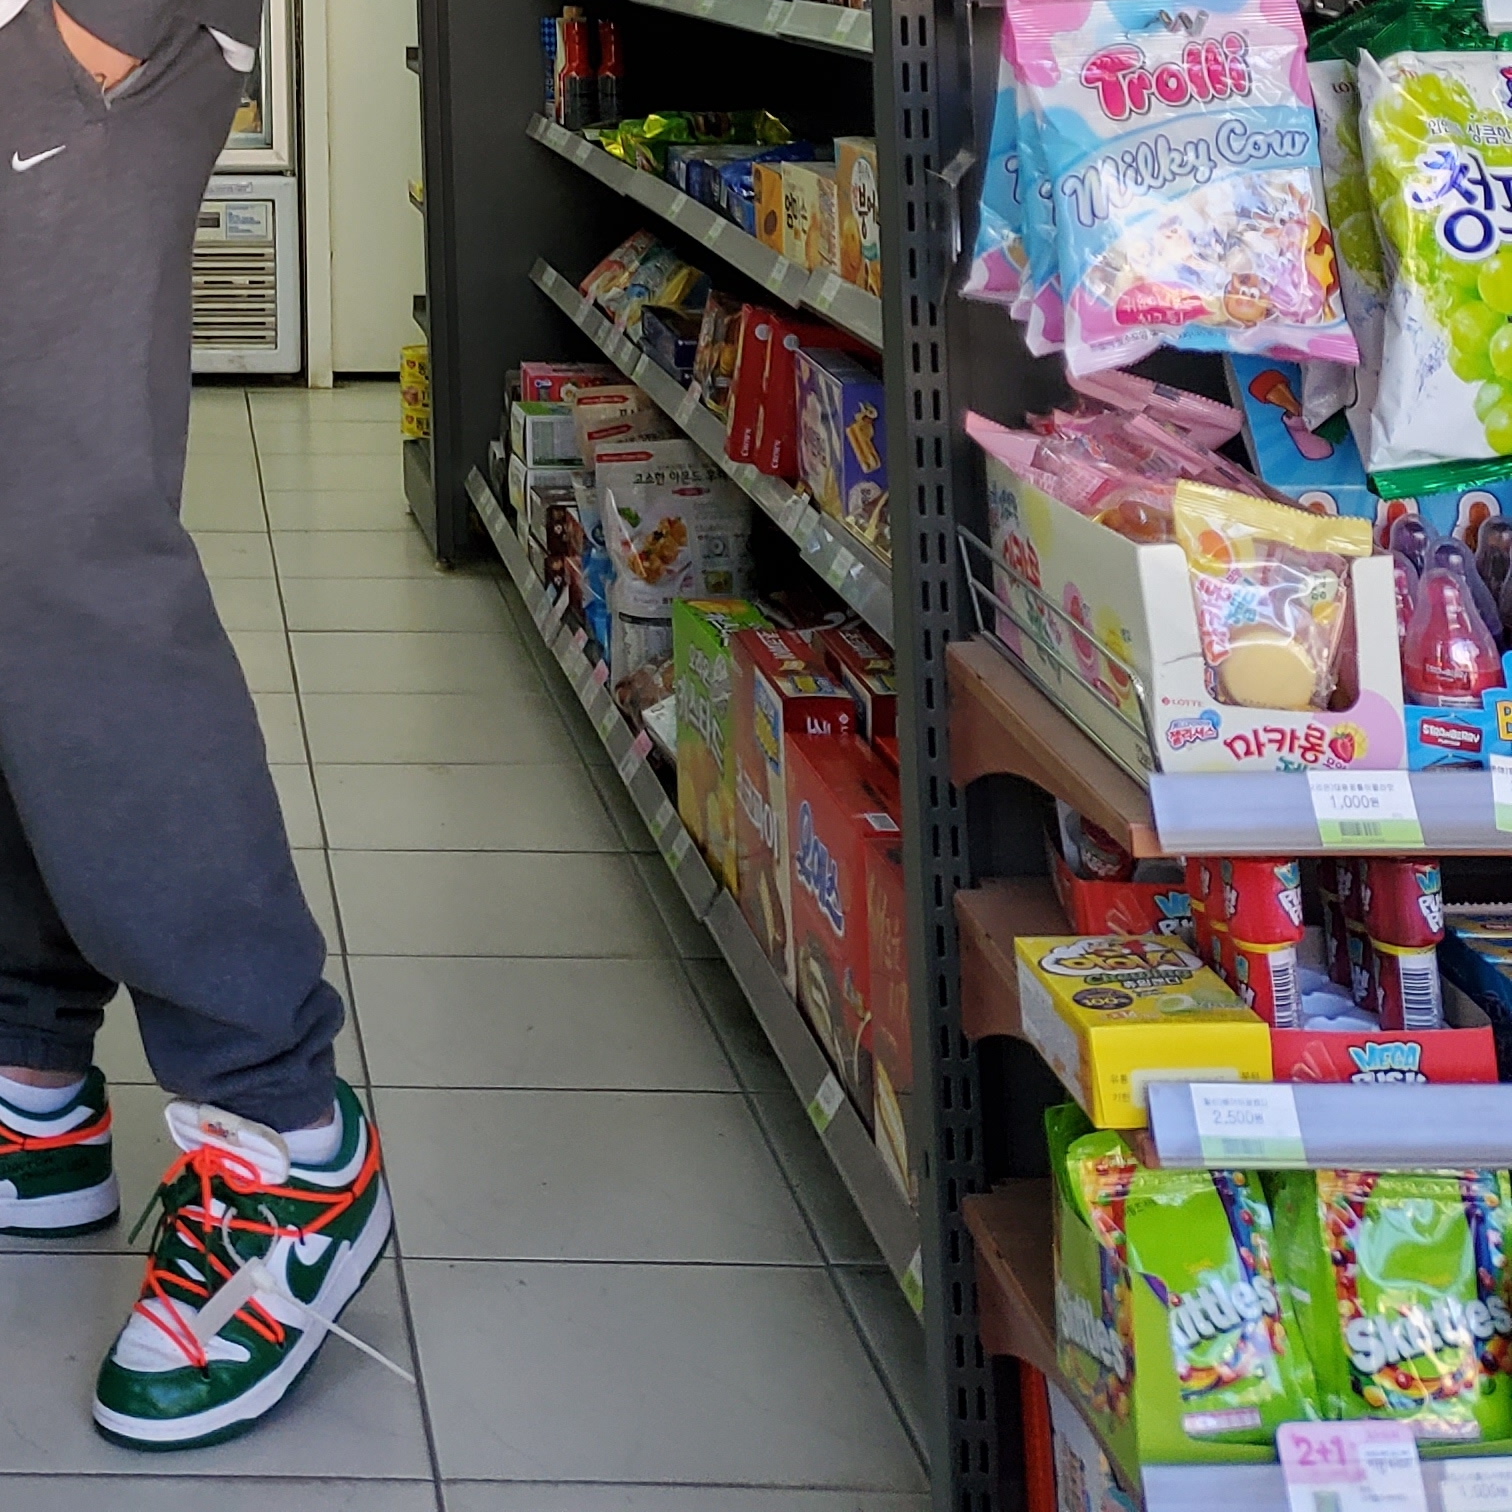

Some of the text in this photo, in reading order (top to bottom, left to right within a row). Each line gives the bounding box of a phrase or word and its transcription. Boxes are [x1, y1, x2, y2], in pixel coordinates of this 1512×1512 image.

[1082, 33, 1253, 120] Trolli
[1063, 119, 1310, 228] Milky Cow
[1172, 698, 1204, 708] LOTTE
[1224, 723, 1328, 765] 마카롱
[1329, 794, 1381, 811] 1,000원
[1349, 1041, 1422, 1071] MEGA
[1212, 1108, 1264, 1125] 2,500원
[1345, 1293, 1511, 1376] Skittles
[1292, 1436, 1347, 1466] 2+1
